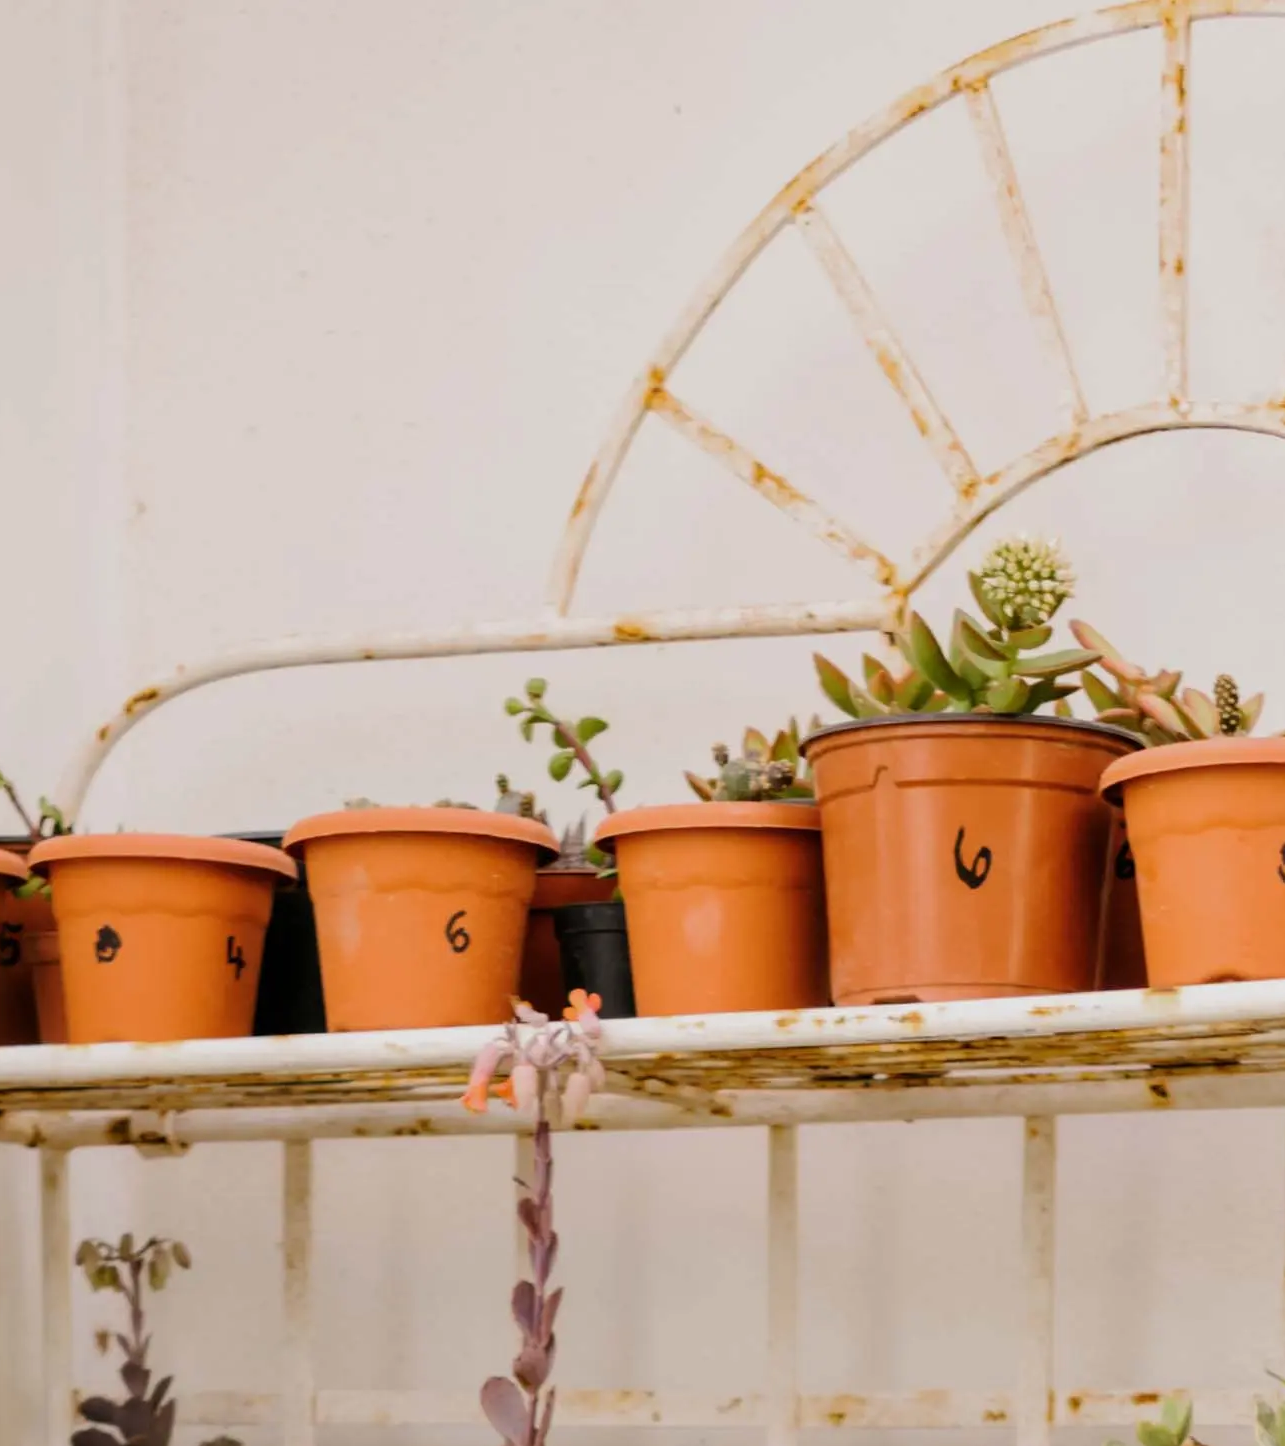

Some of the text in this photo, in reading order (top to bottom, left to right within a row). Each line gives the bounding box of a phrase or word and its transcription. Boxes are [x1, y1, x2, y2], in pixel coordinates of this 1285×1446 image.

[955, 829, 991, 888] 6
[446, 911, 469, 953] 6
[228, 937, 245, 978] 4
